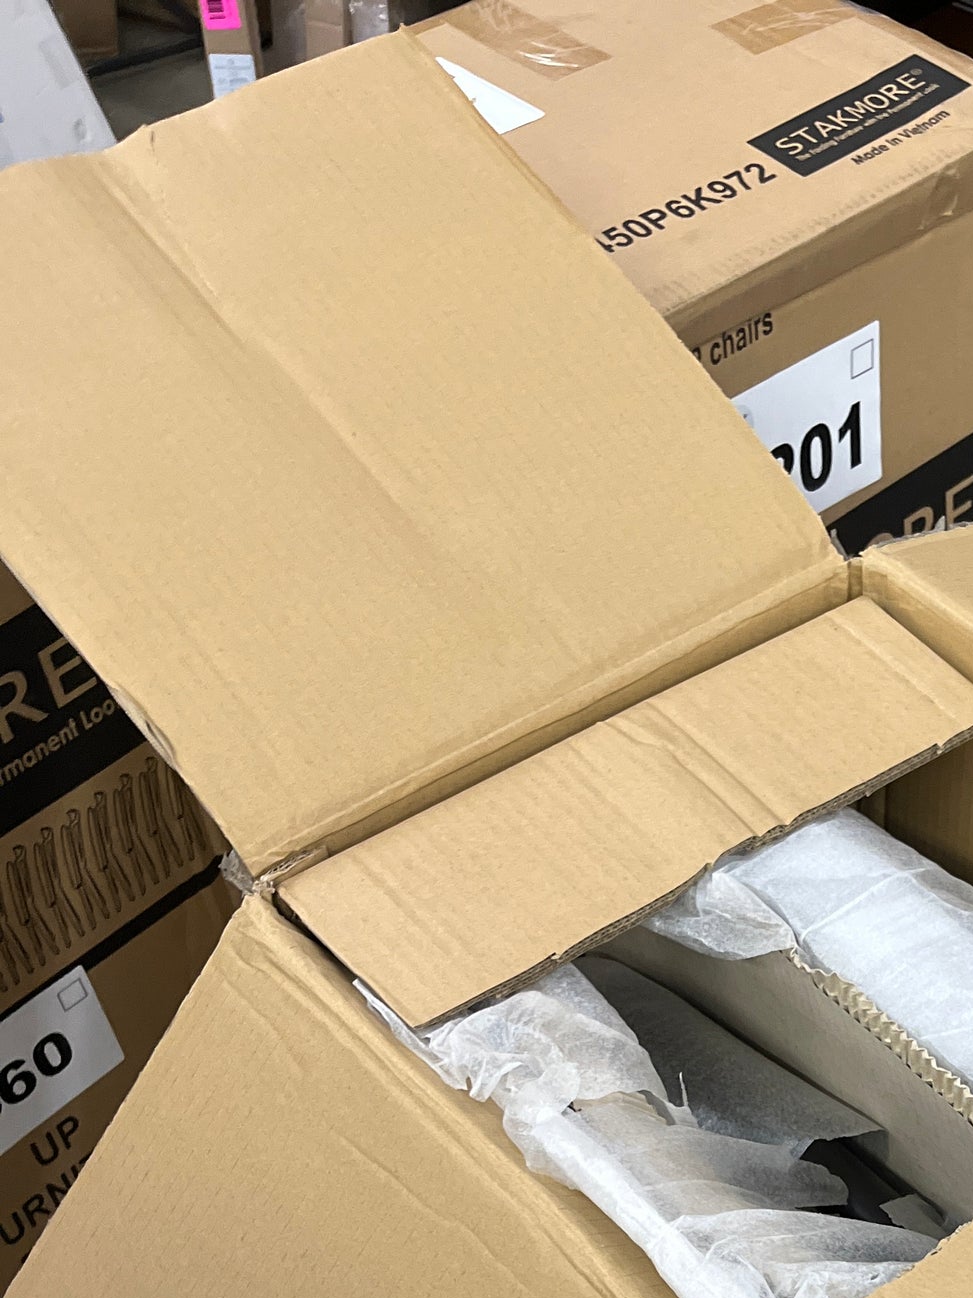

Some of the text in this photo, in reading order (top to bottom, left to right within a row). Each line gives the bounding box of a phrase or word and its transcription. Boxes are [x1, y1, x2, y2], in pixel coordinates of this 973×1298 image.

[850, 144, 889, 165] Made
[898, 110, 950, 139] Vietnam
[709, 312, 773, 365] chairs
[30, 1116, 79, 1166] UP
